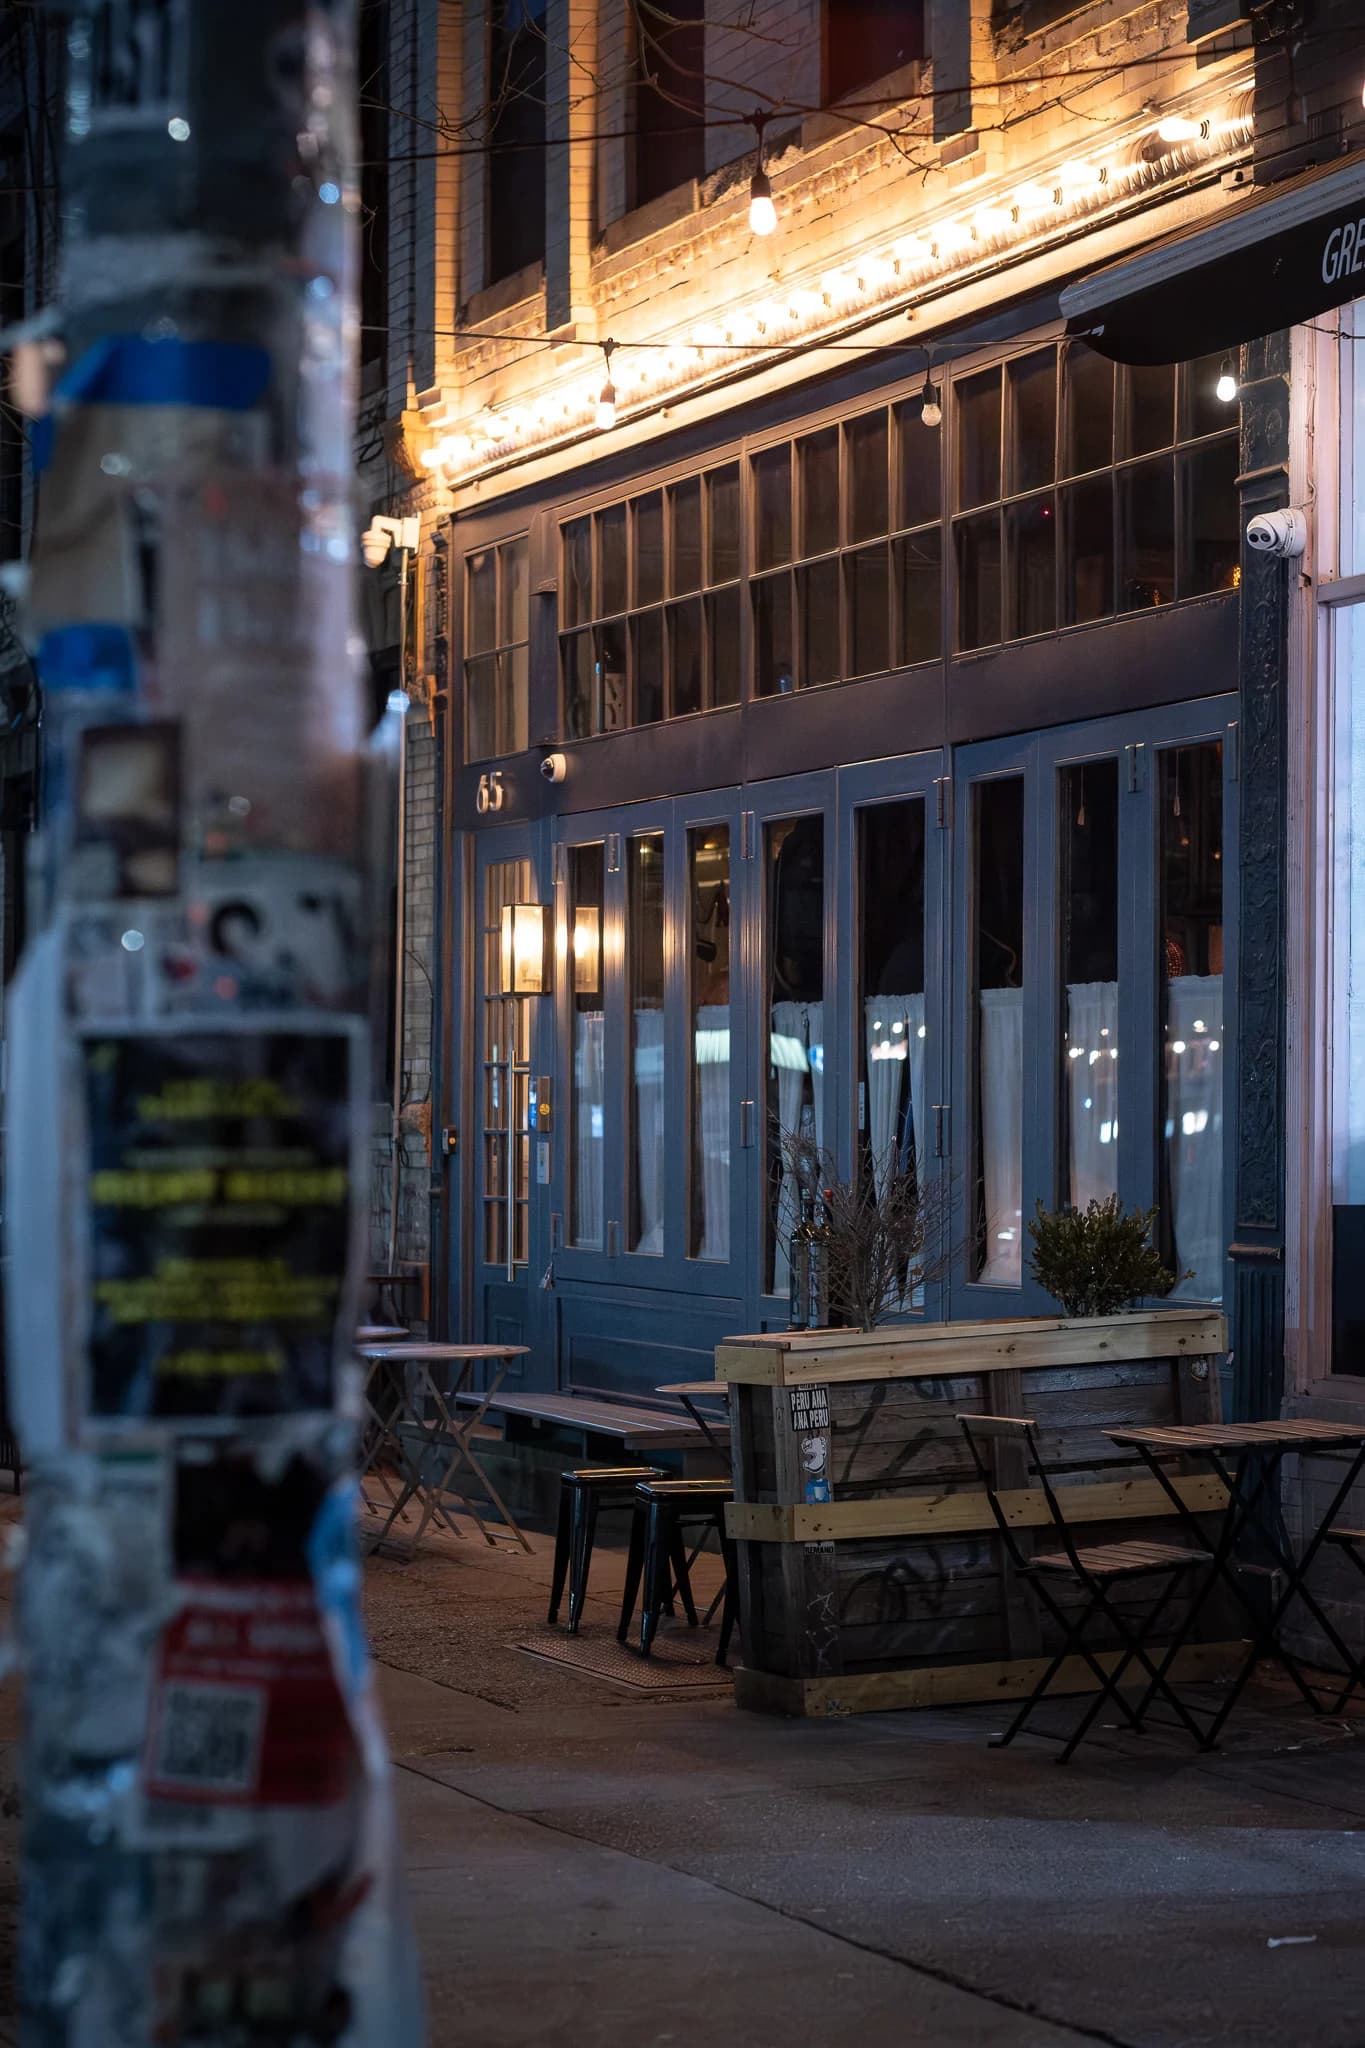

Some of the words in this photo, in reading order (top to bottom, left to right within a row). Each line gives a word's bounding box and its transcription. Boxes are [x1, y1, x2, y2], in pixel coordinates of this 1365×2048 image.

[1322, 217, 1365, 284] GRE
[477, 771, 504, 814] 65
[790, 1391, 810, 1411] PERU
[811, 1389, 828, 1409] ANA
[809, 1408, 829, 1428] PERU
